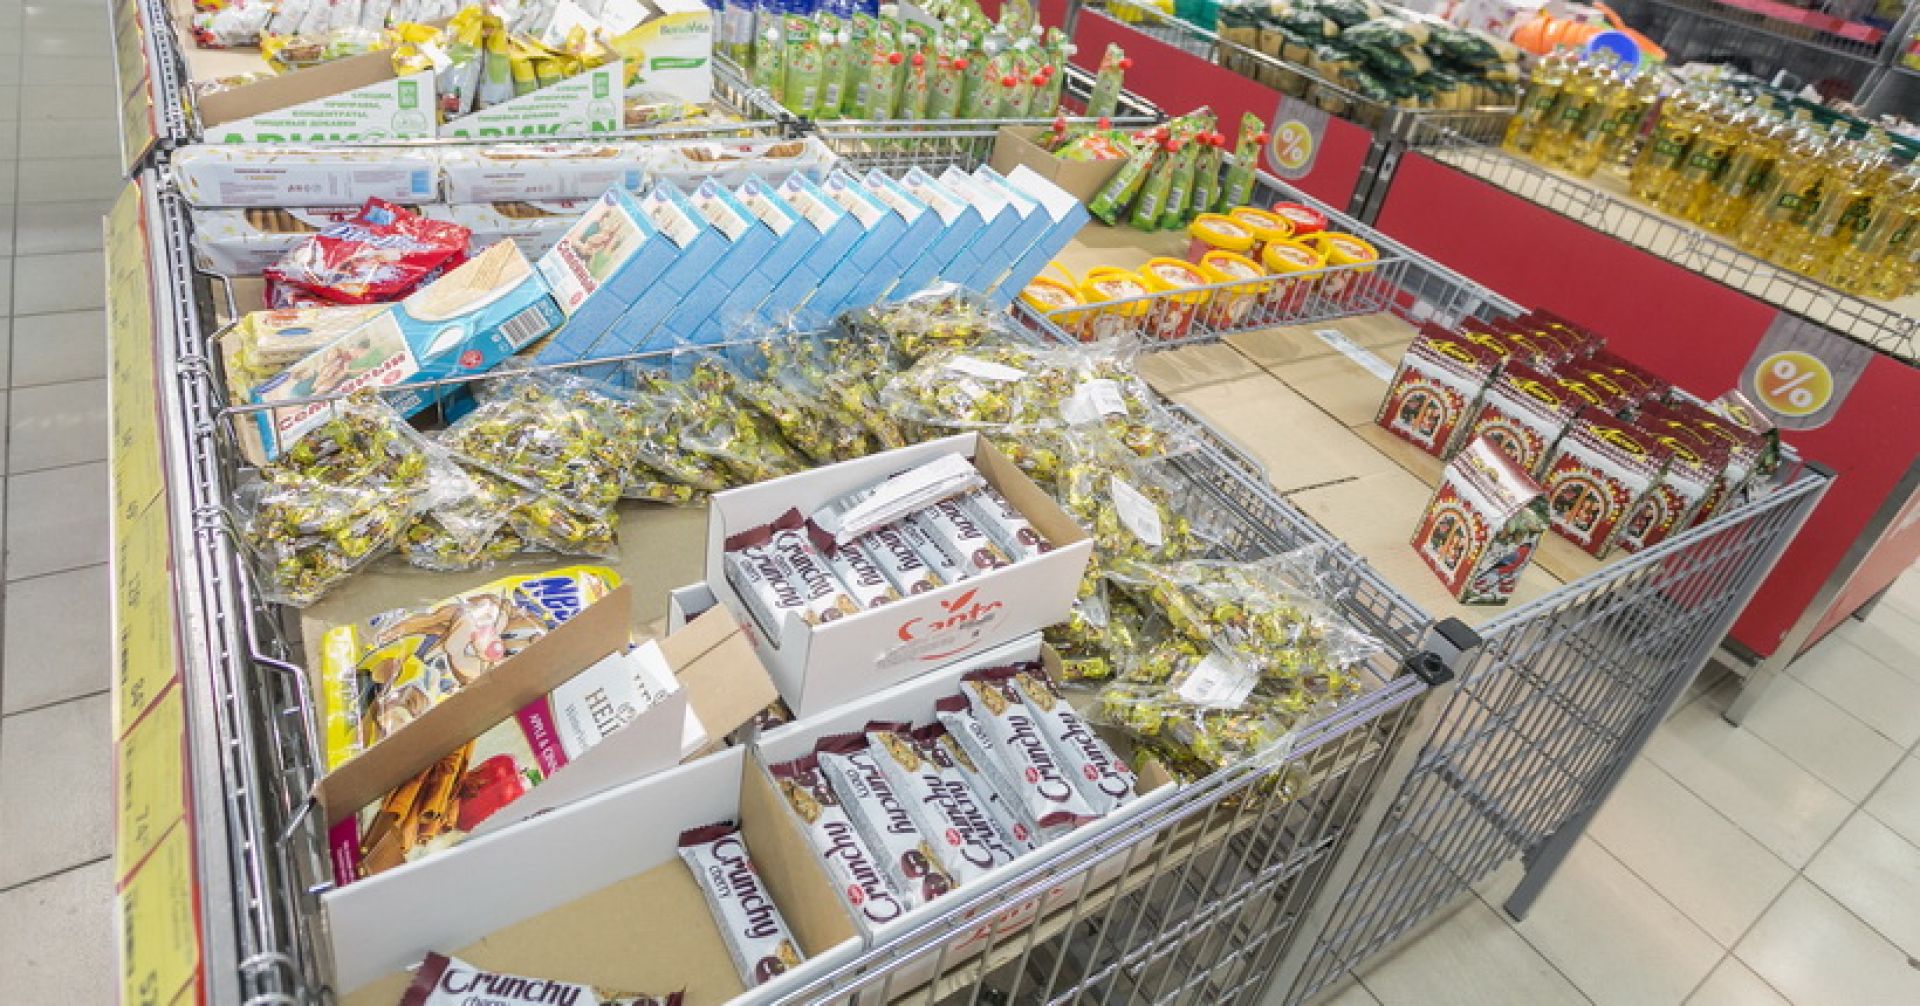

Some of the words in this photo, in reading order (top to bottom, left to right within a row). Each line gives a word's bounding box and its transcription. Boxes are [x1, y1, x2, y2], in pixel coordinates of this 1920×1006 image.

[1007, 715, 1072, 802] Crunchy
[1058, 712, 1130, 799] Crunchy
[922, 775, 994, 869] Crunchy
[711, 837, 779, 938] Crunchy
[823, 822, 902, 924] Crunchy
[442, 968, 582, 1006] Crunchy
